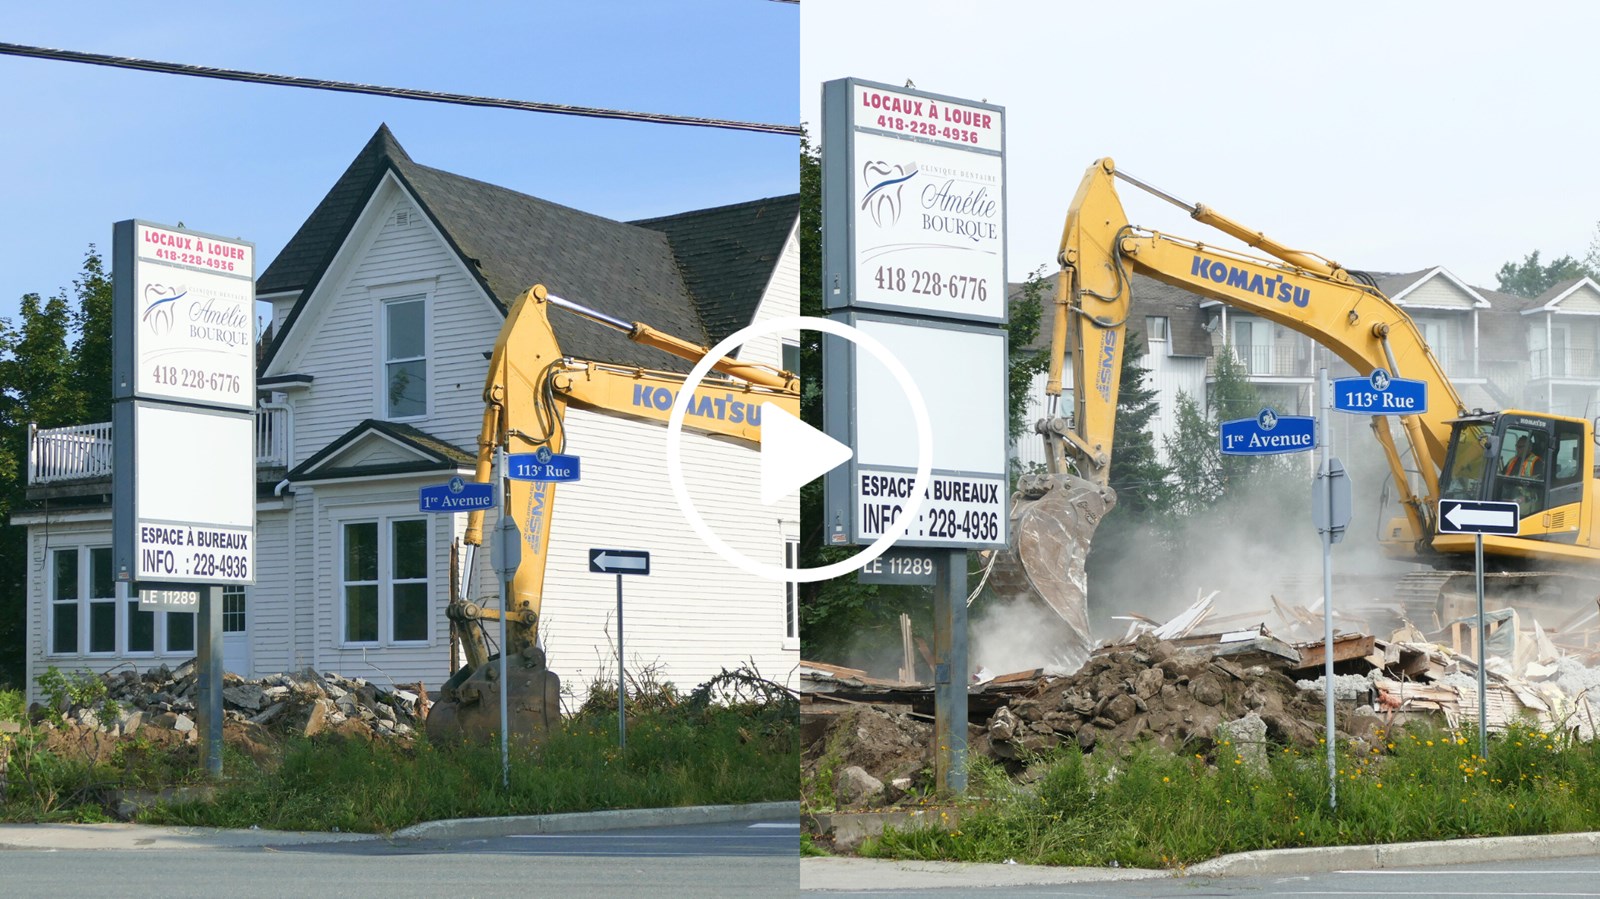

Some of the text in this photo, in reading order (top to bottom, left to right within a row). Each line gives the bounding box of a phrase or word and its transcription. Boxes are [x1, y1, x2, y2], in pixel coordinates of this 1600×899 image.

[863, 92, 991, 129] LOCAUX À LOUER
[877, 115, 978, 144] 418-228-4936
[921, 164, 996, 183] CLINIQUE DENTAIRE
[921, 179, 996, 218] Amélie
[922, 214, 997, 242] BOURQUE
[145, 230, 244, 260] LOCAUX À LOUER
[156, 248, 234, 271] 418-228-4936
[874, 265, 987, 302] 418 228-6776
[1191, 256, 1310, 308] KOMATSU
[189, 298, 247, 328] Amélie
[190, 325, 248, 347] BOURQUE
[153, 365, 240, 393] 418 228-6776
[1382, 392, 1414, 409] Rue
[1225, 432, 1311, 449] 1re Avenue
[545, 466, 570, 478] Rue
[424, 495, 490, 508] 1re Avenue
[934, 480, 998, 504] BUREAUX
[928, 508, 998, 541] 228-4936
[142, 526, 247, 550] ESPACE À BUREAUX
[193, 553, 247, 578] 228-4936
[889, 557, 932, 575] 11289
[142, 590, 196, 605] LE 11289
